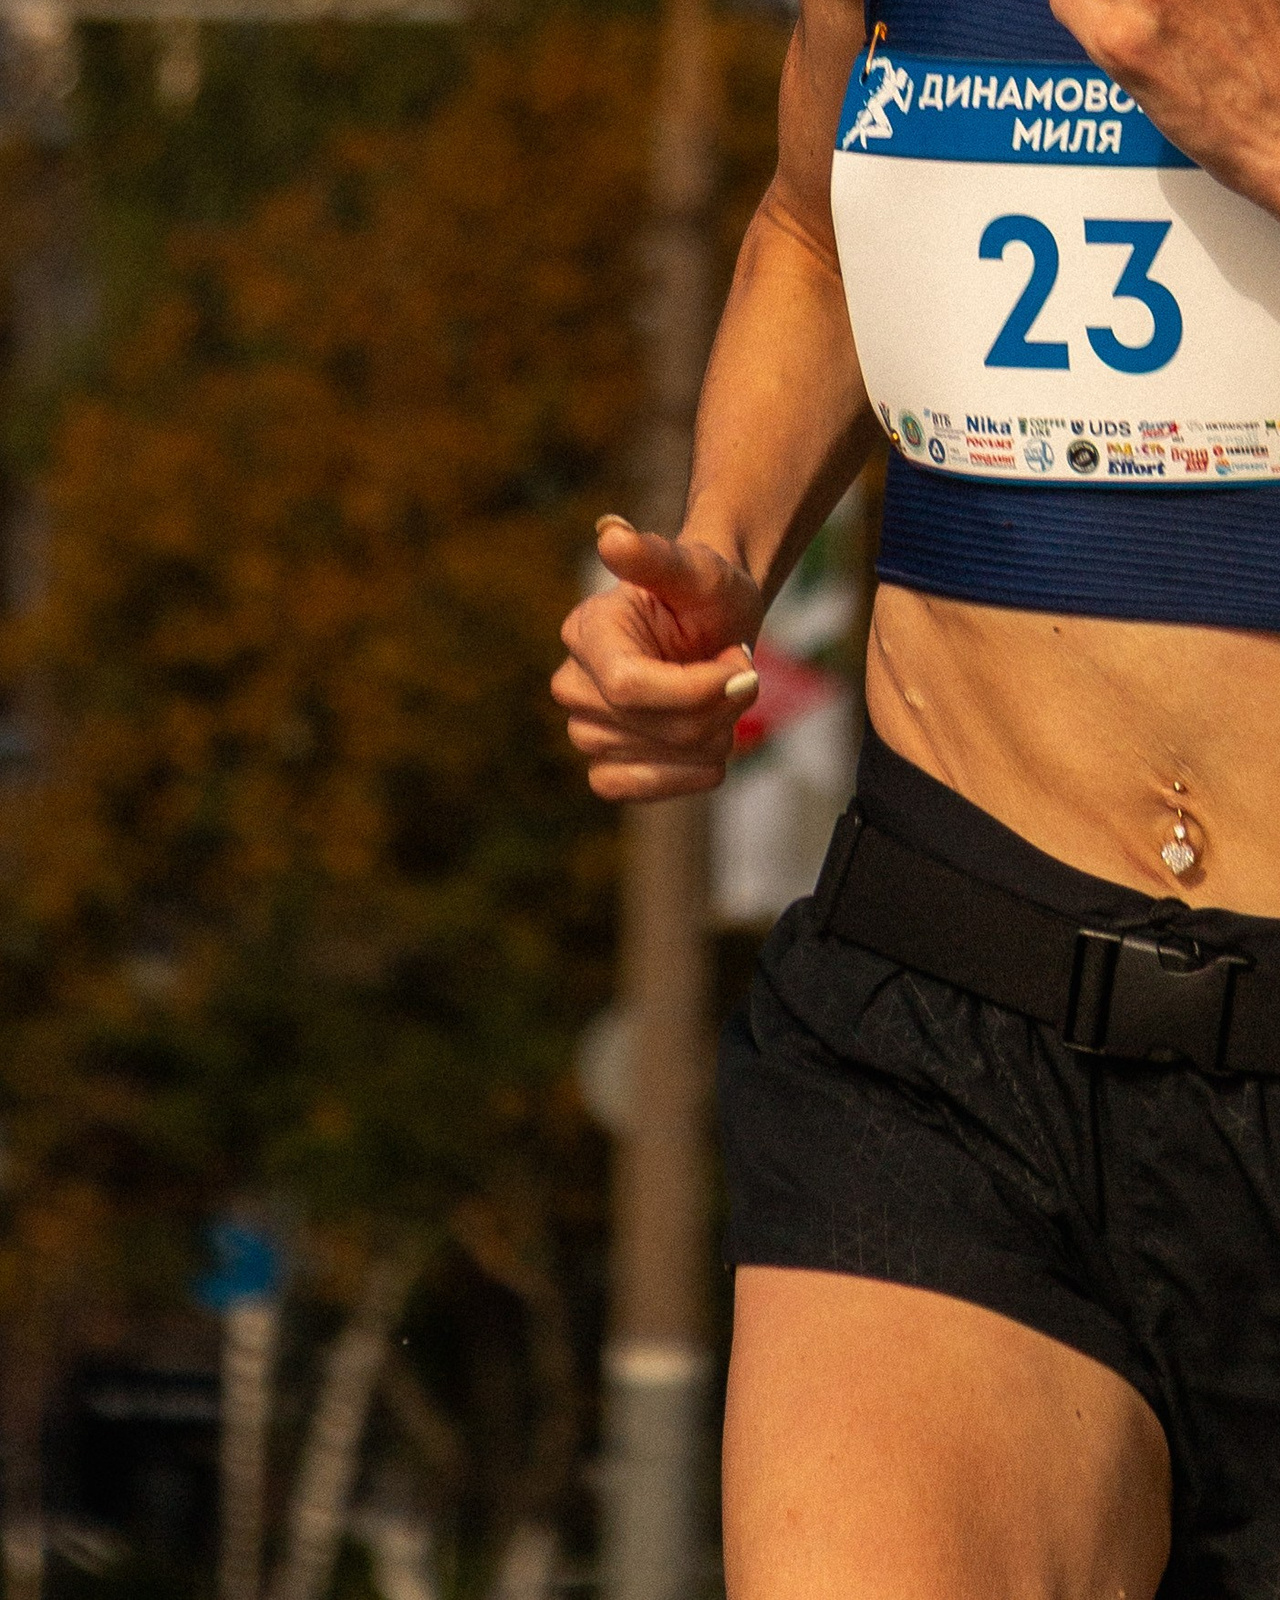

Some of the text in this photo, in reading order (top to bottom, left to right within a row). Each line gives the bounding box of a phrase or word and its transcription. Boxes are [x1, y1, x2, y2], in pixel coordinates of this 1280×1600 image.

[918, 72, 1144, 114] ДИНАМОВС
[1011, 116, 1123, 155] МИЛЯ
[978, 213, 1184, 375] 23
[966, 414, 1012, 435] Nika
[1089, 420, 1131, 437] UDS
